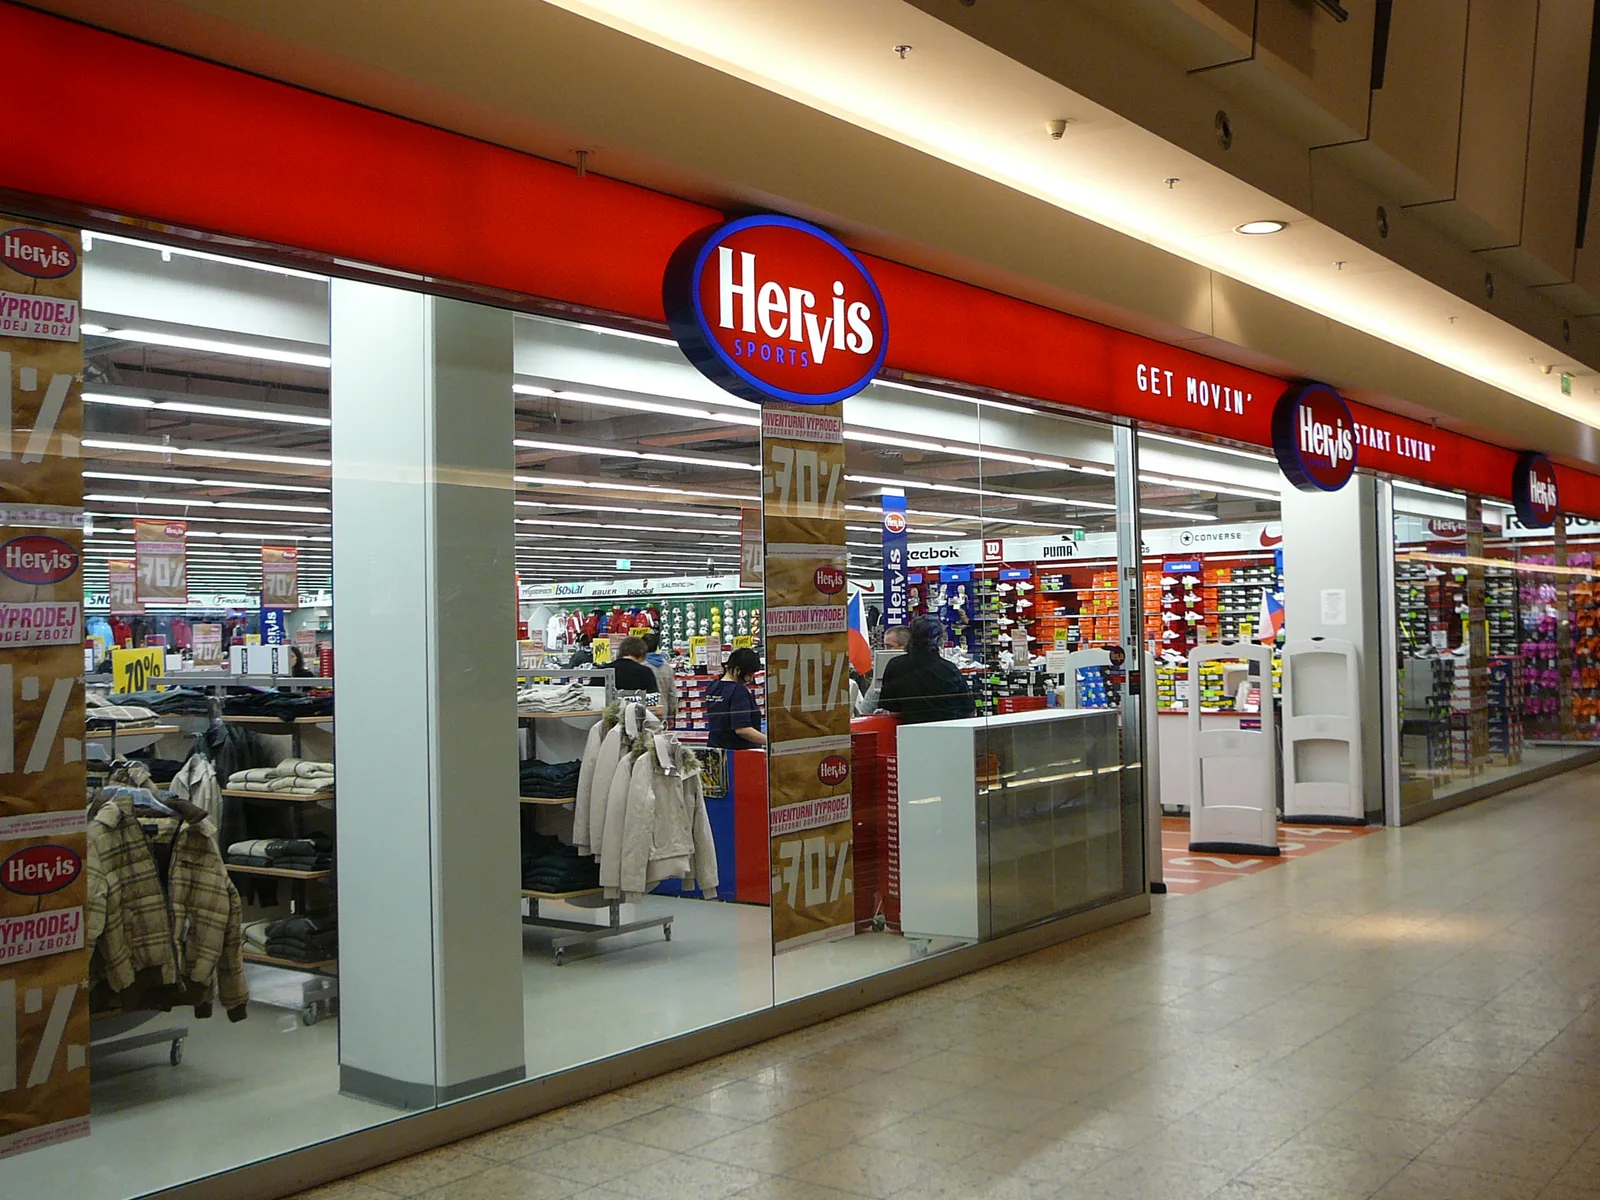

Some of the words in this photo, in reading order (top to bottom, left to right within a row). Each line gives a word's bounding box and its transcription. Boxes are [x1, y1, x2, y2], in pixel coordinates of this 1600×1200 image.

[5, 235, 71, 268] Hervis
[718, 246, 874, 365] Hervis
[34, 322, 72, 337] ZBOŽÍ
[734, 338, 809, 368] SPORTS
[1136, 363, 1174, 398] GET
[1299, 404, 1354, 468] Hervis
[1353, 422, 1391, 452] START
[1529, 470, 1557, 512] Hervis
[1043, 545, 1073, 558] PUMA
[1195, 532, 1242, 542] CONVERSE
[6, 546, 72, 573] Hervis
[817, 570, 843, 588] Hervis
[887, 548, 905, 625] Hervis
[36, 627, 74, 640] ZBOŽÍ
[265, 611, 280, 645] ervis
[820, 761, 847, 778] Hervis
[8, 855, 75, 883] Hervis
[39, 932, 77, 951] ZBOŽÍ
